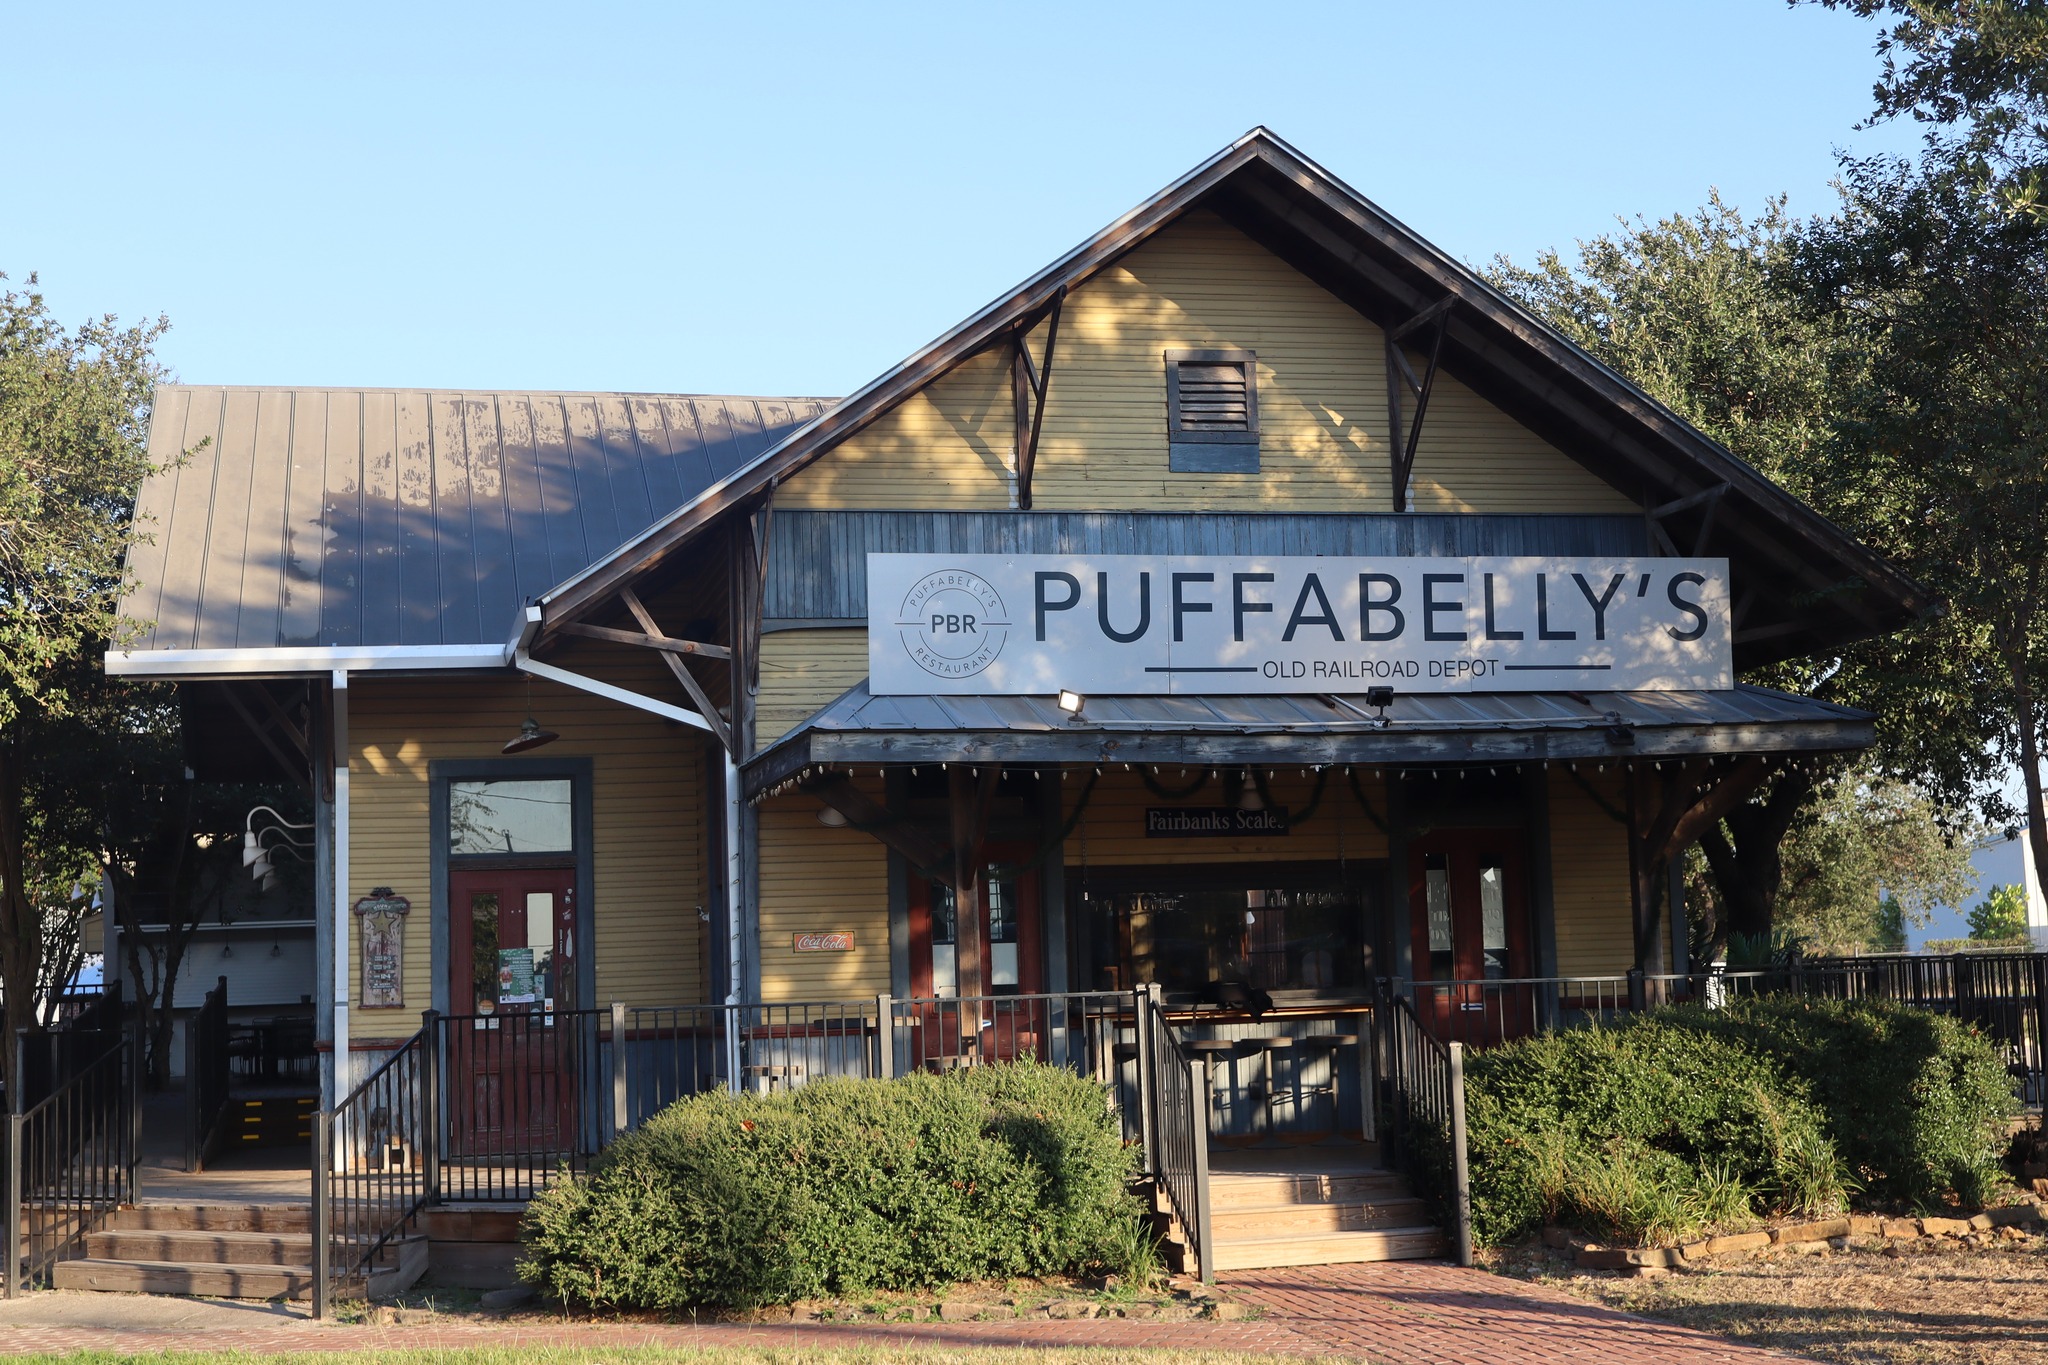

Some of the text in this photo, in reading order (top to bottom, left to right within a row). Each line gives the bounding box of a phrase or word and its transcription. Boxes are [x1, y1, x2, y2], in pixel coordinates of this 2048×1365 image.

[909, 575, 997, 608] PUFFABELLY'S
[1034, 571, 1708, 643] PUFFABELLY'S
[931, 614, 977, 634] PBR
[915, 646, 993, 674] RESTAURANT
[1263, 659, 1499, 679] OLD RAILROAD DEPOT
[1148, 809, 1286, 830] Fairbanks Scale
